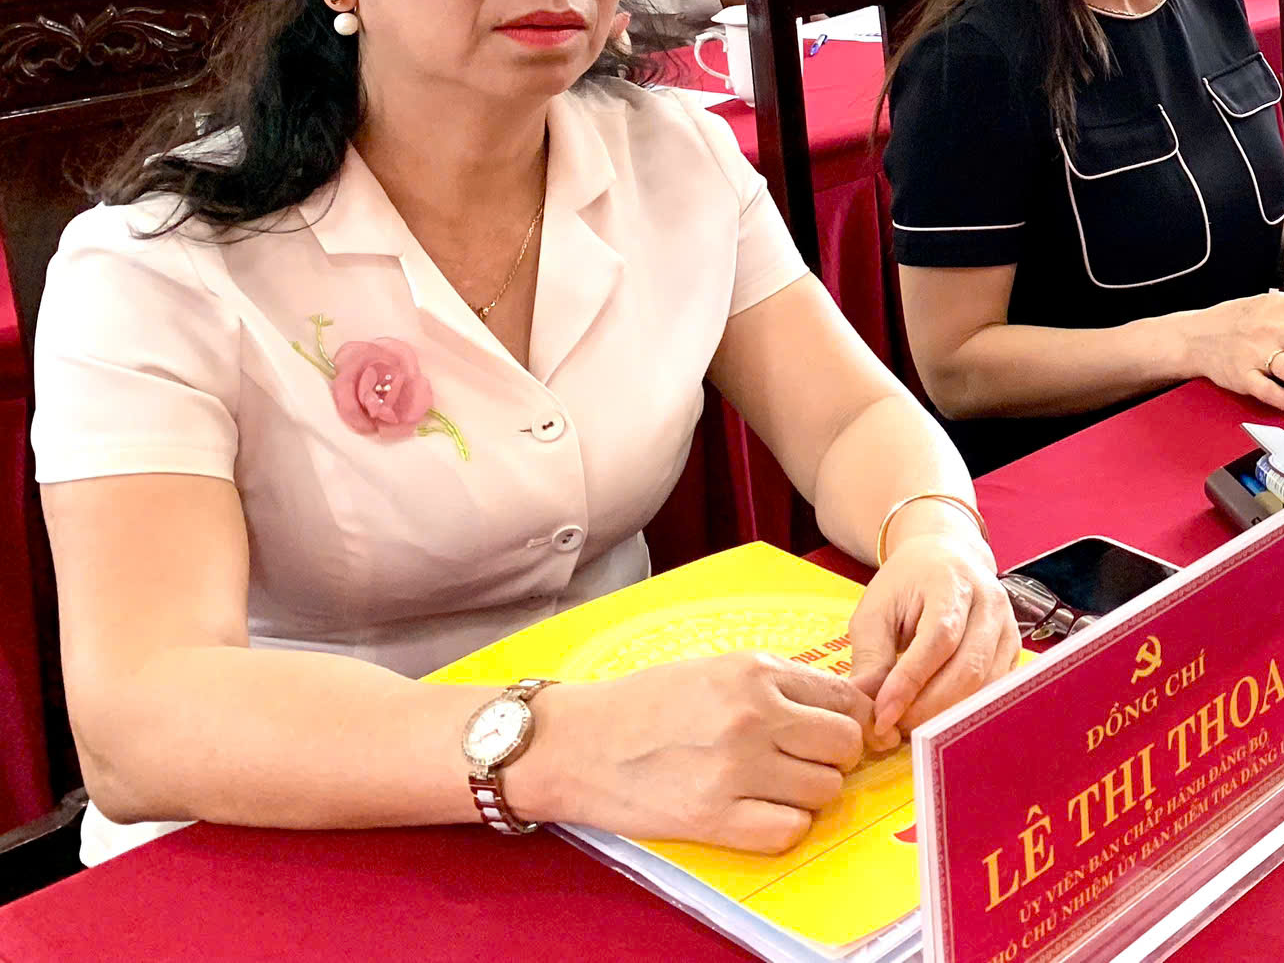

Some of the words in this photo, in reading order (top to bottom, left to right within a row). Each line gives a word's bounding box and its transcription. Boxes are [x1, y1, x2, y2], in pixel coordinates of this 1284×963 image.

[1086, 688, 1159, 753] ĐỒNG
[1164, 648, 1206, 697] CHÍ
[981, 804, 1056, 913] LÊ
[1067, 743, 1157, 848] THỊ
[988, 939, 1019, 963] HÓ
[1061, 868, 1115, 921] NHIỆM
[1140, 828, 1172, 861] BAN
[1211, 777, 1239, 806] TRA
[1045, 864, 1086, 904] VIÊN
[1088, 839, 1121, 874] BAN
[1123, 806, 1165, 845] CHẤP
[1166, 774, 1207, 816] HÀNH
[1249, 727, 1269, 752] BỘ
